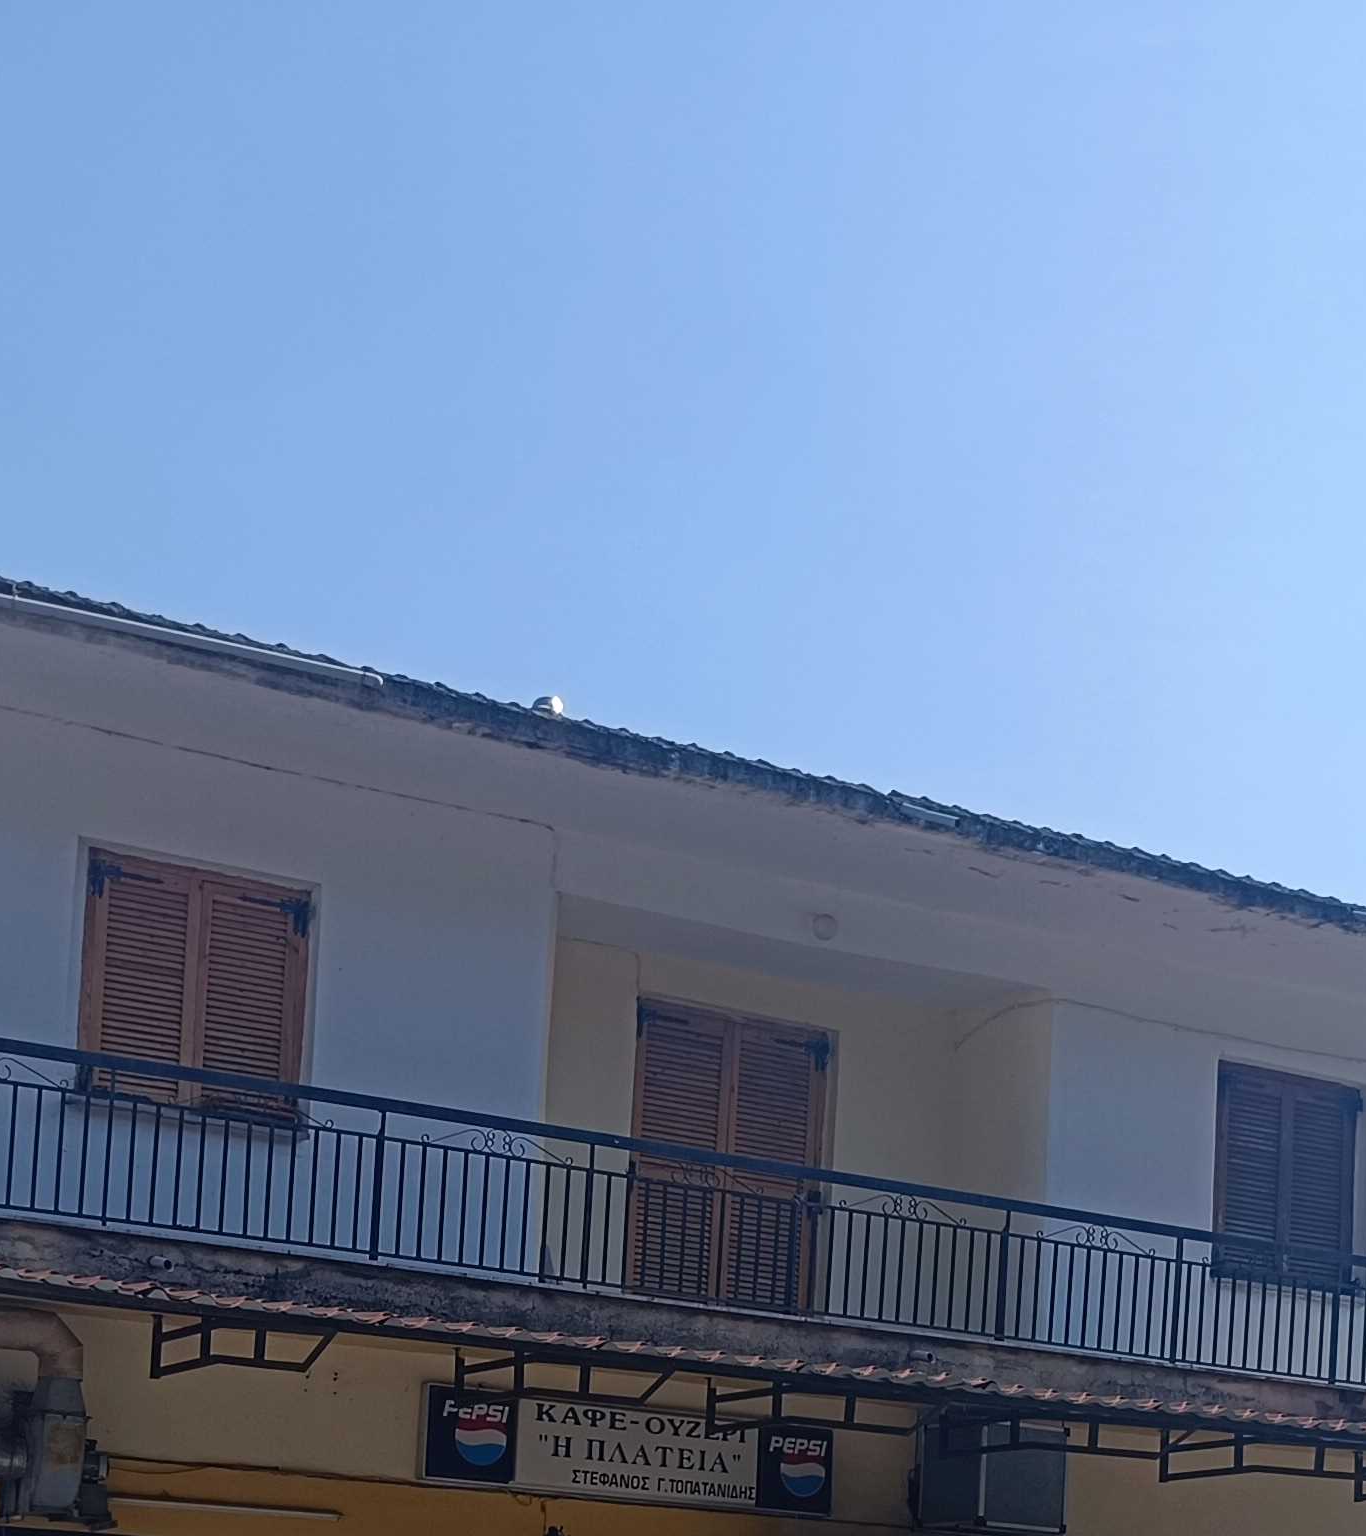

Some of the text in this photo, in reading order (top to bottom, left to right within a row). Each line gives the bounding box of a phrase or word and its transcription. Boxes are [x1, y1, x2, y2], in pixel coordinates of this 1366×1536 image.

[443, 1399, 510, 1423] PEPSI
[769, 1436, 827, 1457] PEPSI
[571, 1469, 650, 1491] ΣΤΕΦΑΝΟΣ
